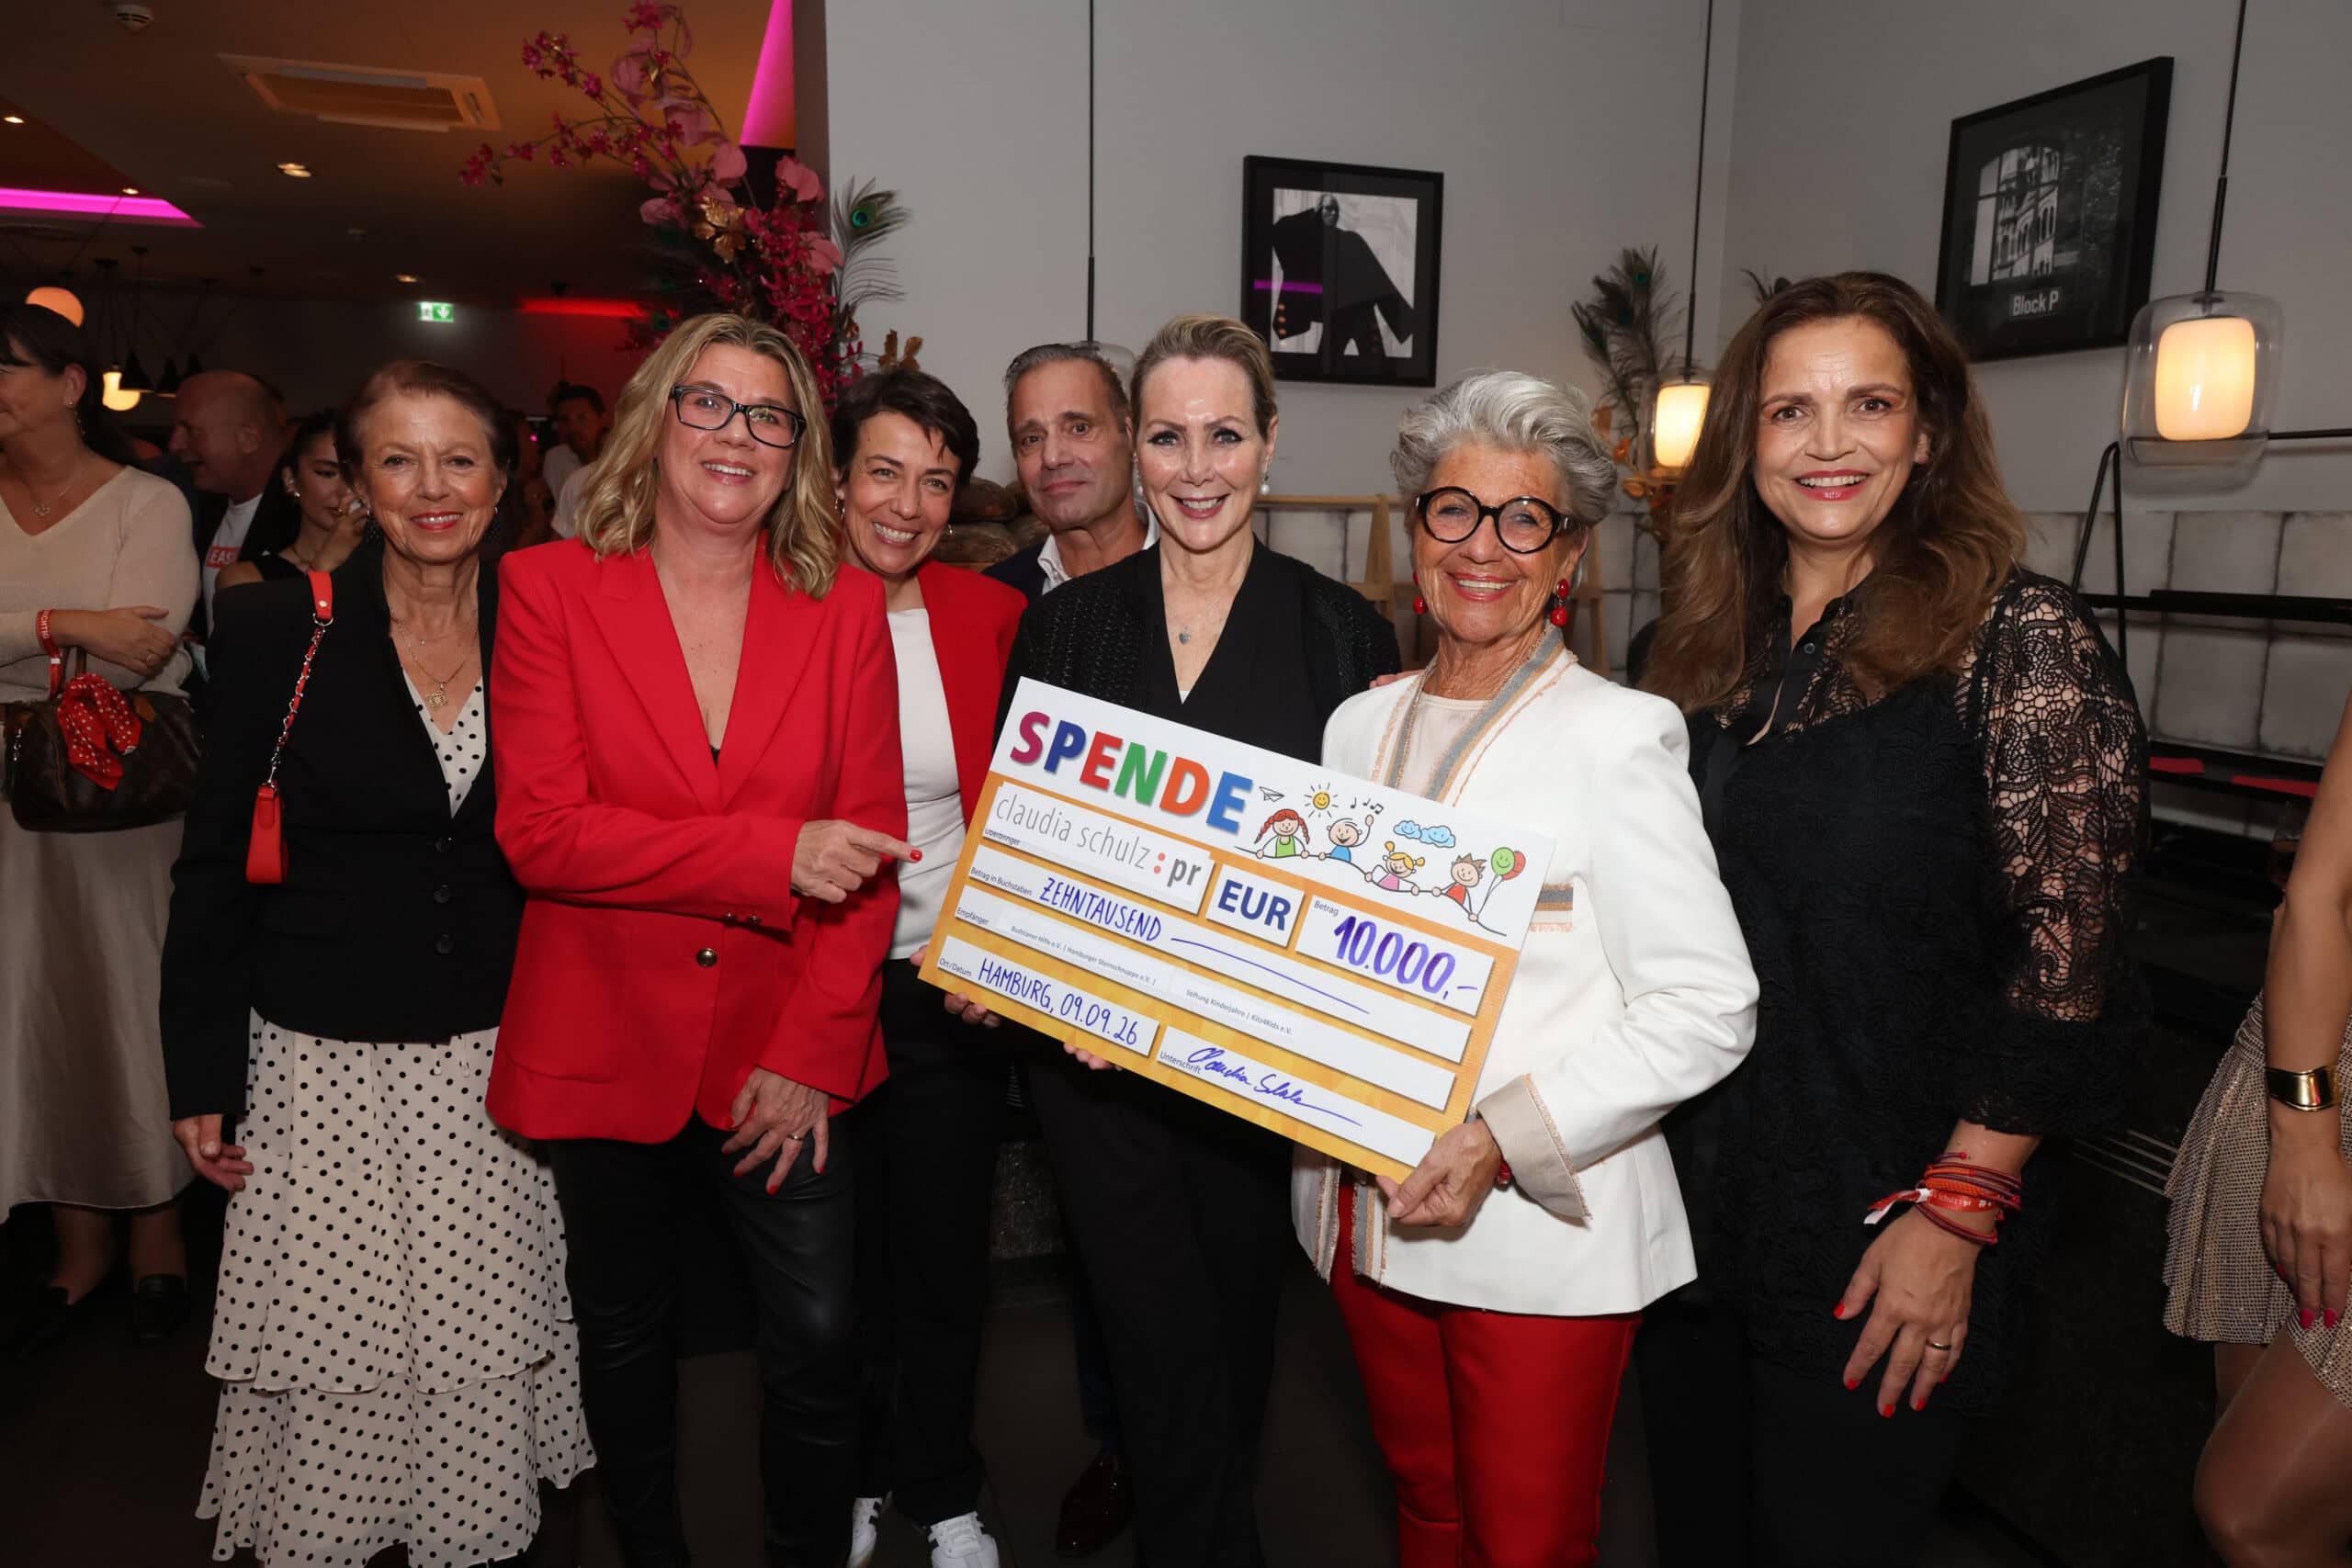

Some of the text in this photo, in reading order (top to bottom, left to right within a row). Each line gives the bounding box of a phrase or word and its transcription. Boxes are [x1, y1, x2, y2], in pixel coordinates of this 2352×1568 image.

[2012, 290, 2059, 317] Block P
[1010, 711, 1254, 835] SPENDE
[996, 795, 1071, 842] claudia
[970, 867, 990, 883] Betrag
[997, 876, 1033, 897] Buchstaben
[956, 907, 990, 926] Empfänger
[1039, 877, 1161, 942] ZEHNTAUSEND
[1217, 878, 1292, 931] EUR
[1314, 900, 1340, 917] Betrag
[939, 958, 972, 977] Ort/Datum
[1067, 946, 1098, 964] Hamburger
[1098, 956, 1139, 980] Sternschnuppe
[978, 958, 1138, 1045] HAMBURG, 09.09.26
[1186, 989, 1210, 1005] Stiftung
[1210, 998, 1246, 1017] Kinderjahre
[1159, 1051, 1202, 1075] Unterschrift
